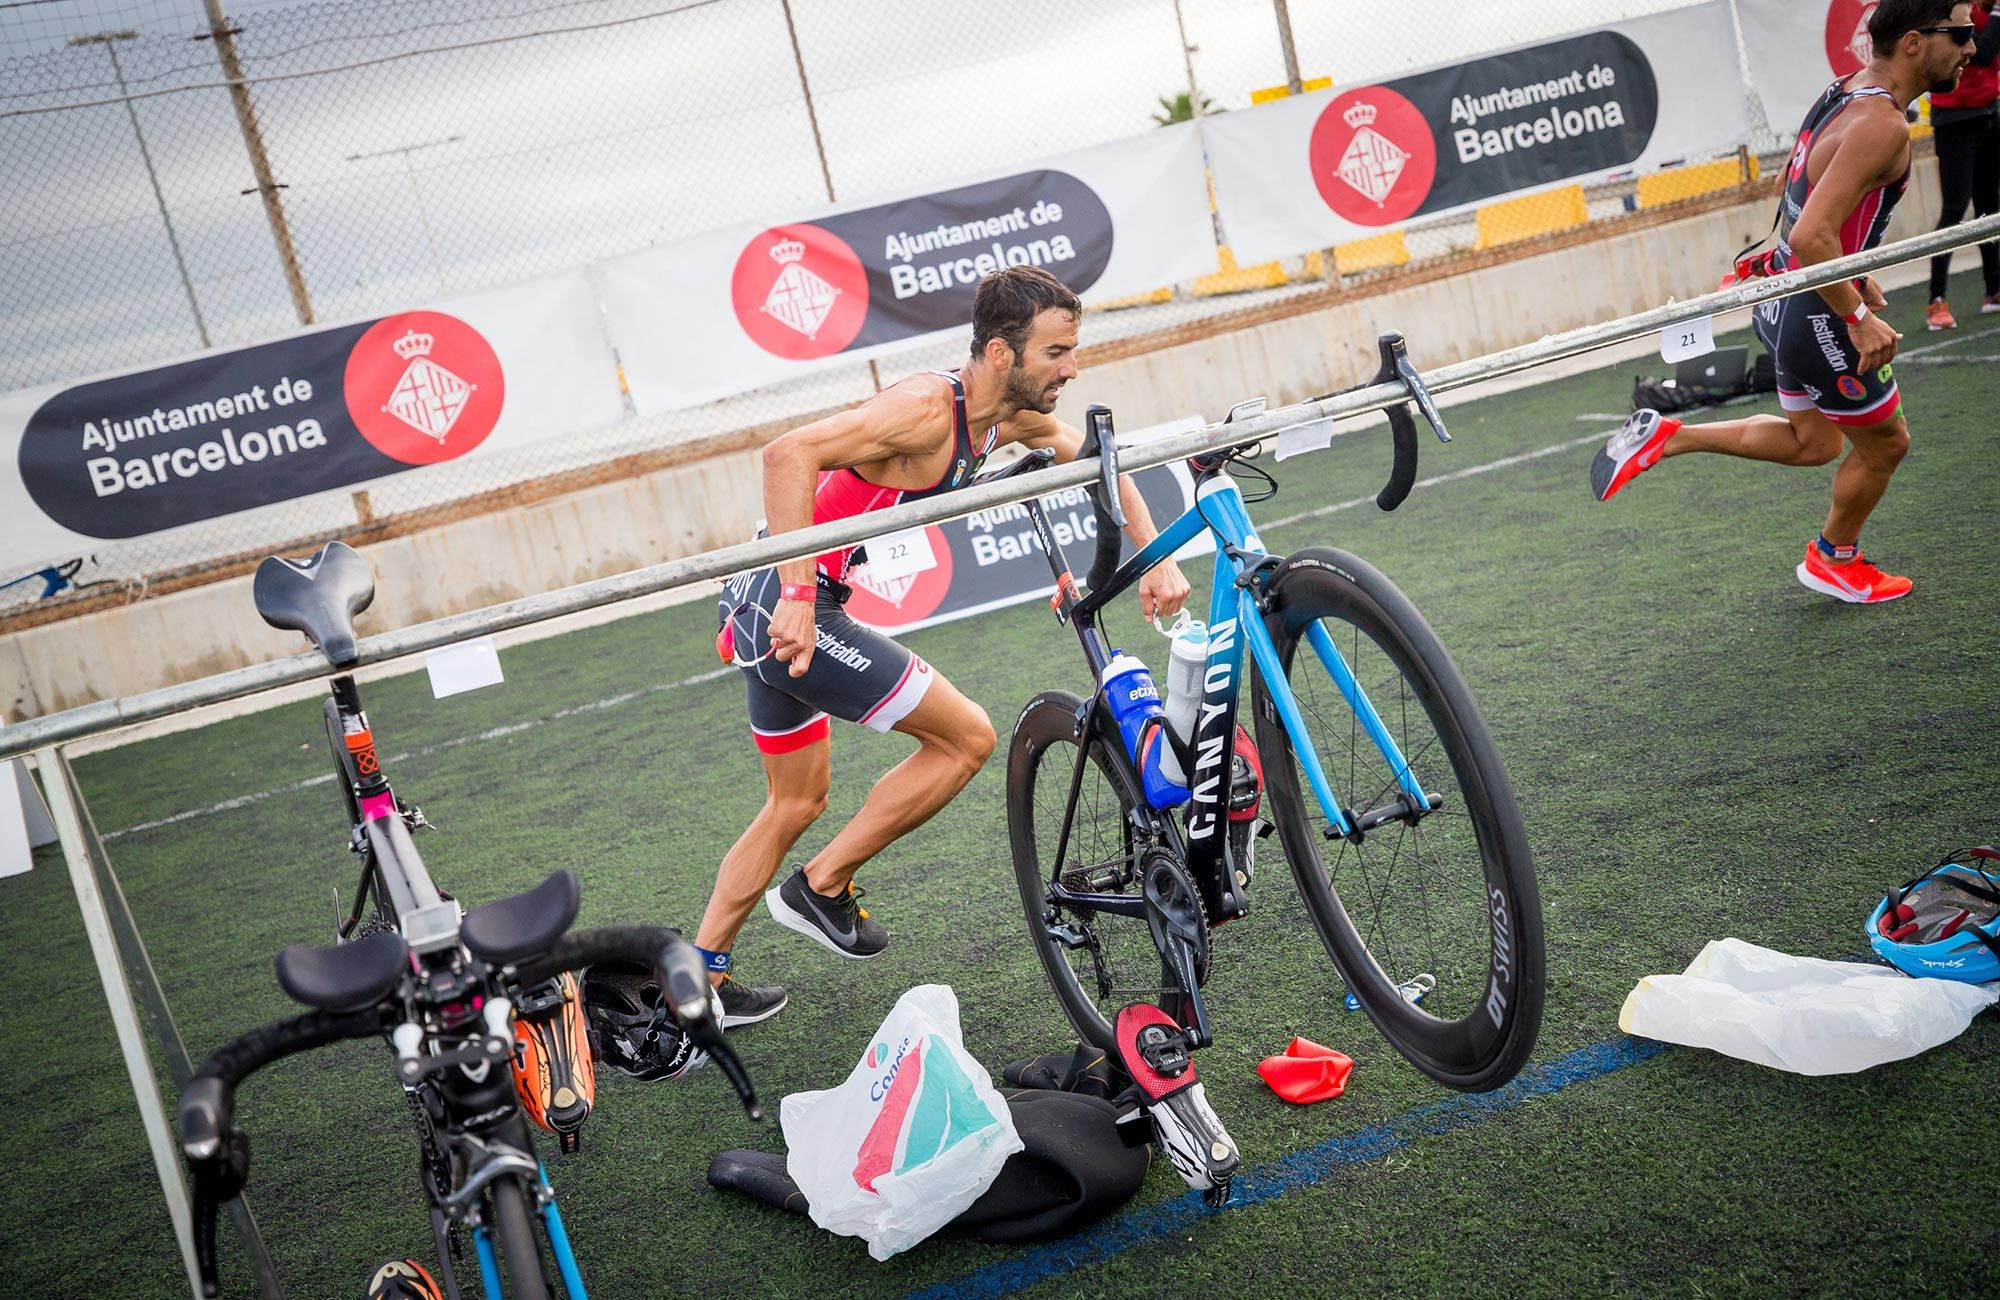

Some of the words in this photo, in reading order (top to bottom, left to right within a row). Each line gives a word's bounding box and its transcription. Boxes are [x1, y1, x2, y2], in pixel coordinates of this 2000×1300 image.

[1450, 70, 1586, 126] Ajuntament
[1585, 63, 1616, 90] de
[1453, 100, 1626, 164] Barcelona
[885, 207, 1030, 262] Ajuntament
[1030, 199, 1064, 226] de
[888, 234, 1077, 300] Barcelona
[1681, 332, 1697, 347] 21
[82, 384, 270, 453] Ajuntament
[271, 376, 313, 406] de
[86, 418, 328, 498] Barcelona
[889, 544, 909, 560] 22
[1188, 617, 1238, 840] CANYON
[1488, 883, 1510, 984] SWISS
[1486, 974, 1507, 1030] DT
